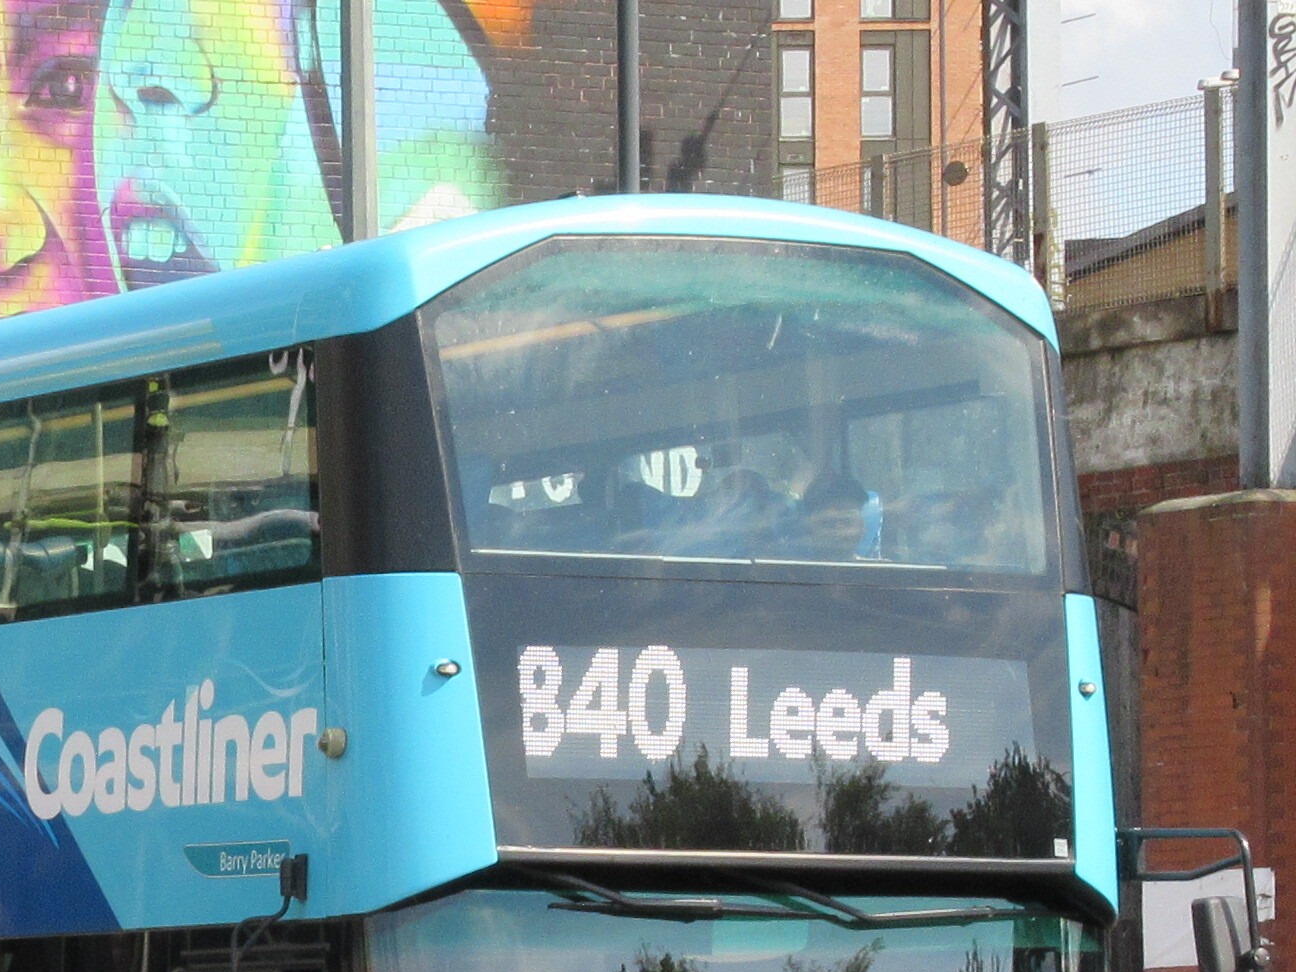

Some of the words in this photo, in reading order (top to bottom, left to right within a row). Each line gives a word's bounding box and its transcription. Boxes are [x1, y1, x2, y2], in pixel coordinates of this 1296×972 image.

[24, 678, 318, 820] Coastliner
[518, 643, 687, 760] 840
[729, 657, 949, 763] Leeds
[219, 851, 248, 875] Barry
[250, 847, 285, 870] Parker
